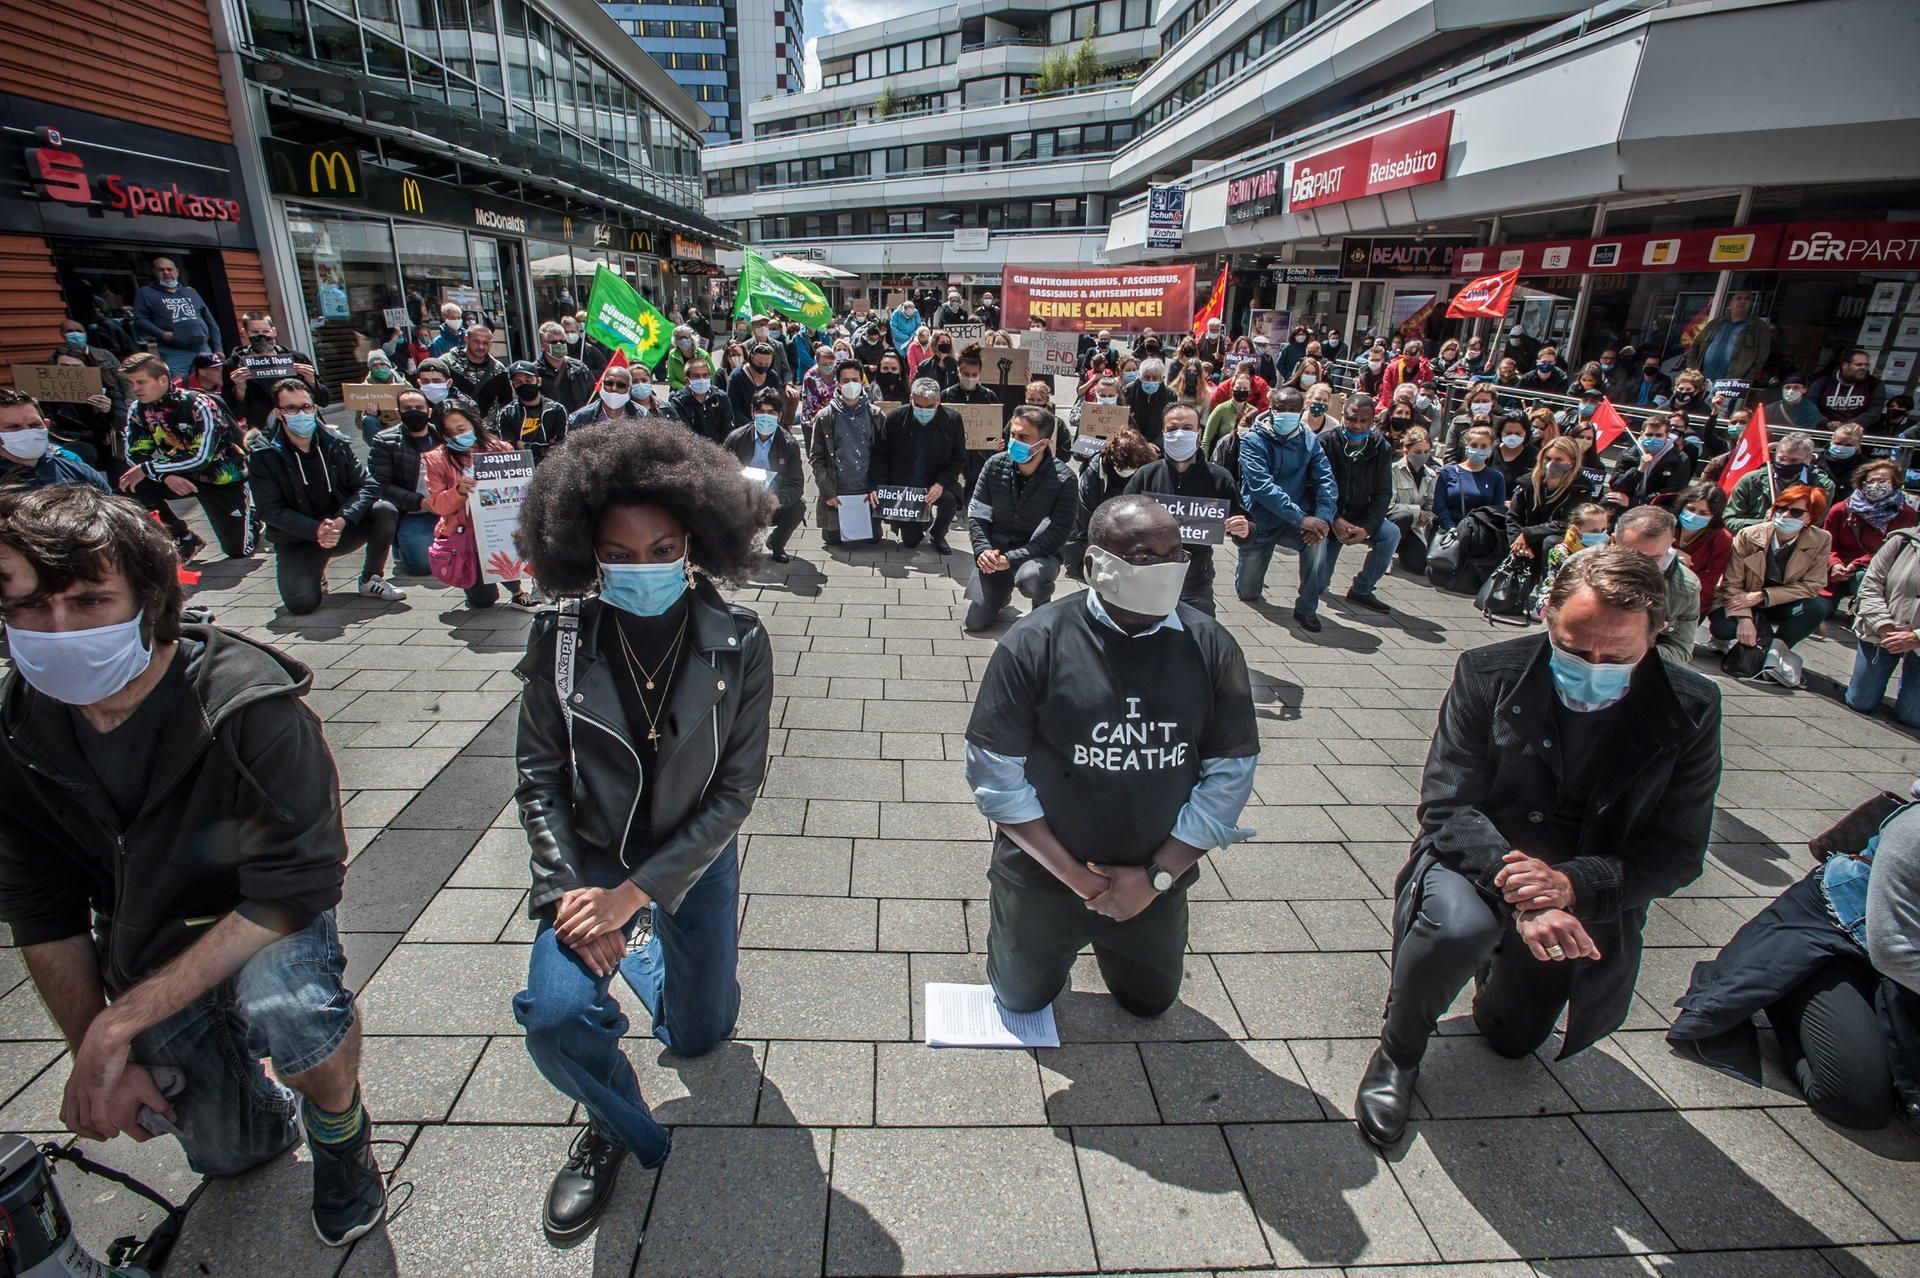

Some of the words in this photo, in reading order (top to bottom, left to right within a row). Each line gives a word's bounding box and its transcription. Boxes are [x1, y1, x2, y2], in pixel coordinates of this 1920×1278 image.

[1369, 150, 1436, 184] Reisebüro
[107, 175, 241, 223] Sparkasse
[475, 207, 525, 233] McDonald's
[1151, 211, 1174, 219] Schuh
[1372, 246, 1436, 264] BEAUTY
[1013, 275, 1029, 283] GIB
[1029, 277, 1121, 287] ANTIKOMMUNISMUS,
[1122, 275, 1181, 285] FASCHISMUS,
[1029, 288, 1079, 298] RASSISMUS
[1080, 289, 1088, 298] &
[1089, 288, 1164, 298] ANTISEMITISMUS
[1029, 301, 1082, 318] KEINE
[1085, 301, 1163, 318] CHANCE!
[602, 303, 637, 329] BÜNDNIS
[636, 325, 645, 337] 90
[599, 311, 612, 325] DIE
[612, 321, 641, 345] GRÜNEN
[246, 357, 271, 366] Black
[271, 356, 293, 365] lives
[1046, 349, 1074, 364] END
[36, 367, 85, 379] BLACK
[40, 380, 88, 391] LIVES
[483, 453, 521, 465] matter
[476, 470, 502, 481] lives
[504, 467, 533, 480] Black
[878, 489, 903, 501] Black
[905, 491, 926, 502] live
[883, 507, 920, 518] matter
[1189, 502, 1225, 519] lives
[1179, 526, 1209, 540] tter
[1126, 697, 1141, 719] I
[1092, 722, 1178, 745] CAN'T
[1073, 742, 1188, 771] BREATHE
